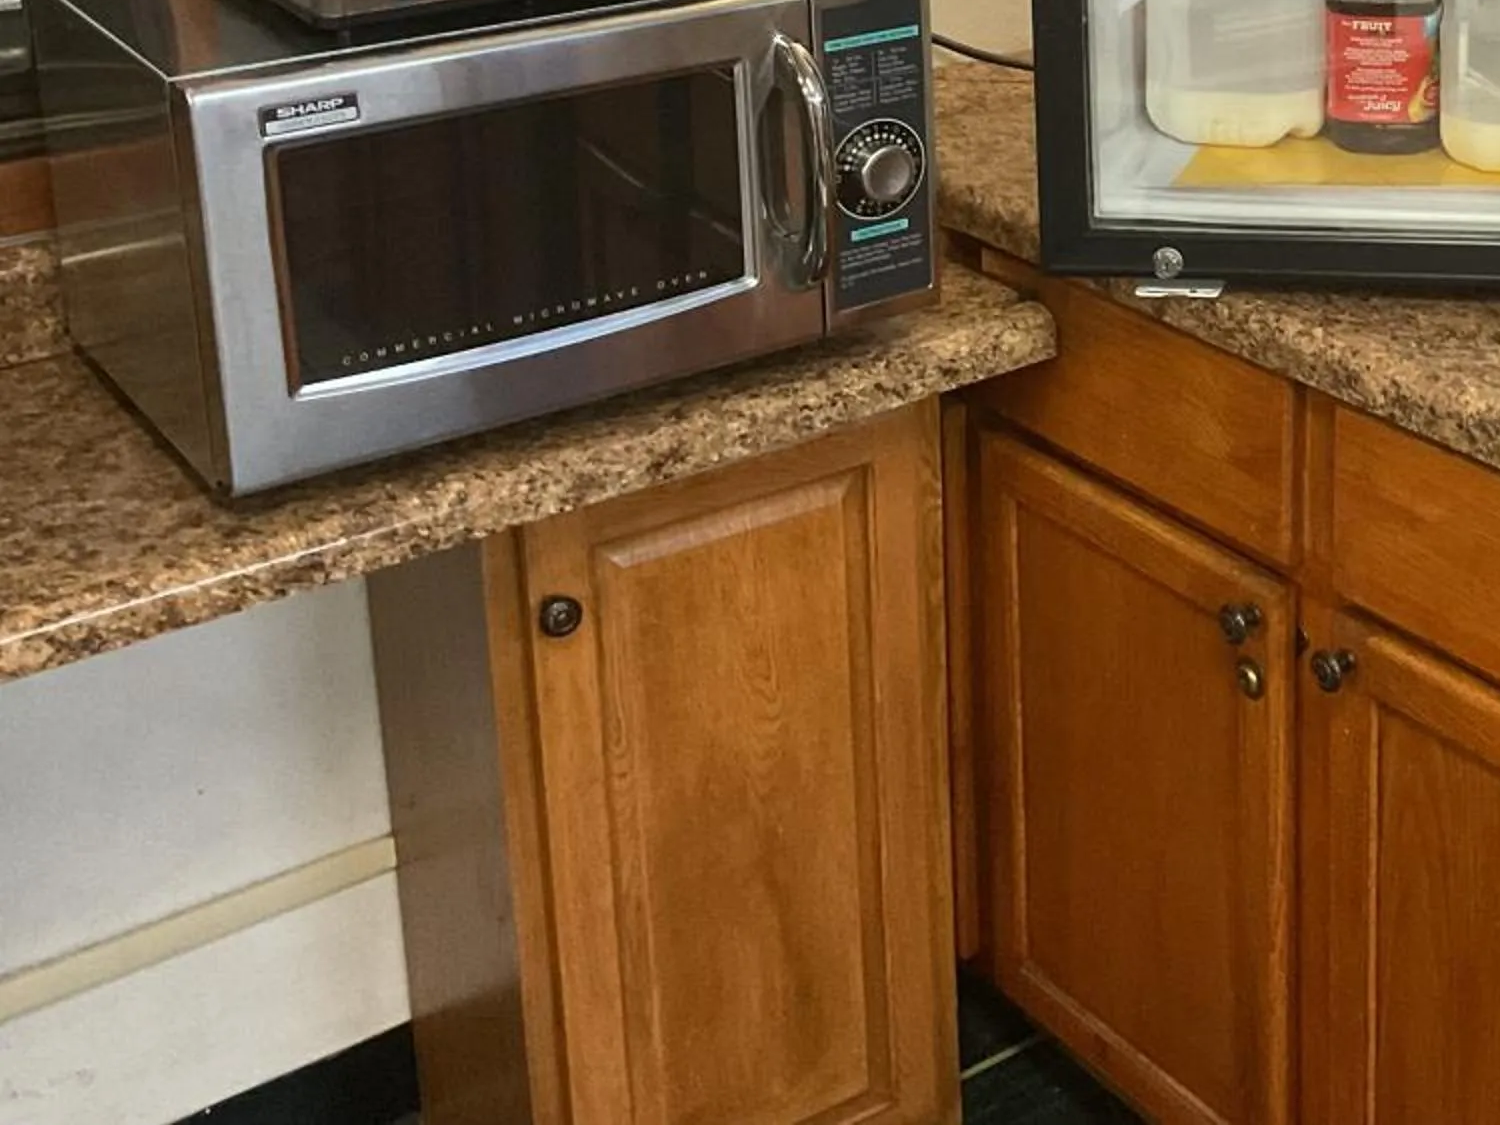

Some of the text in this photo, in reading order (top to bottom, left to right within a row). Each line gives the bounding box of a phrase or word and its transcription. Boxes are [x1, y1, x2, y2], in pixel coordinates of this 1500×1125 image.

[276, 97, 344, 118] SHARP
[343, 270, 707, 367] COMMERCIAL MICROWAVE OVEN
